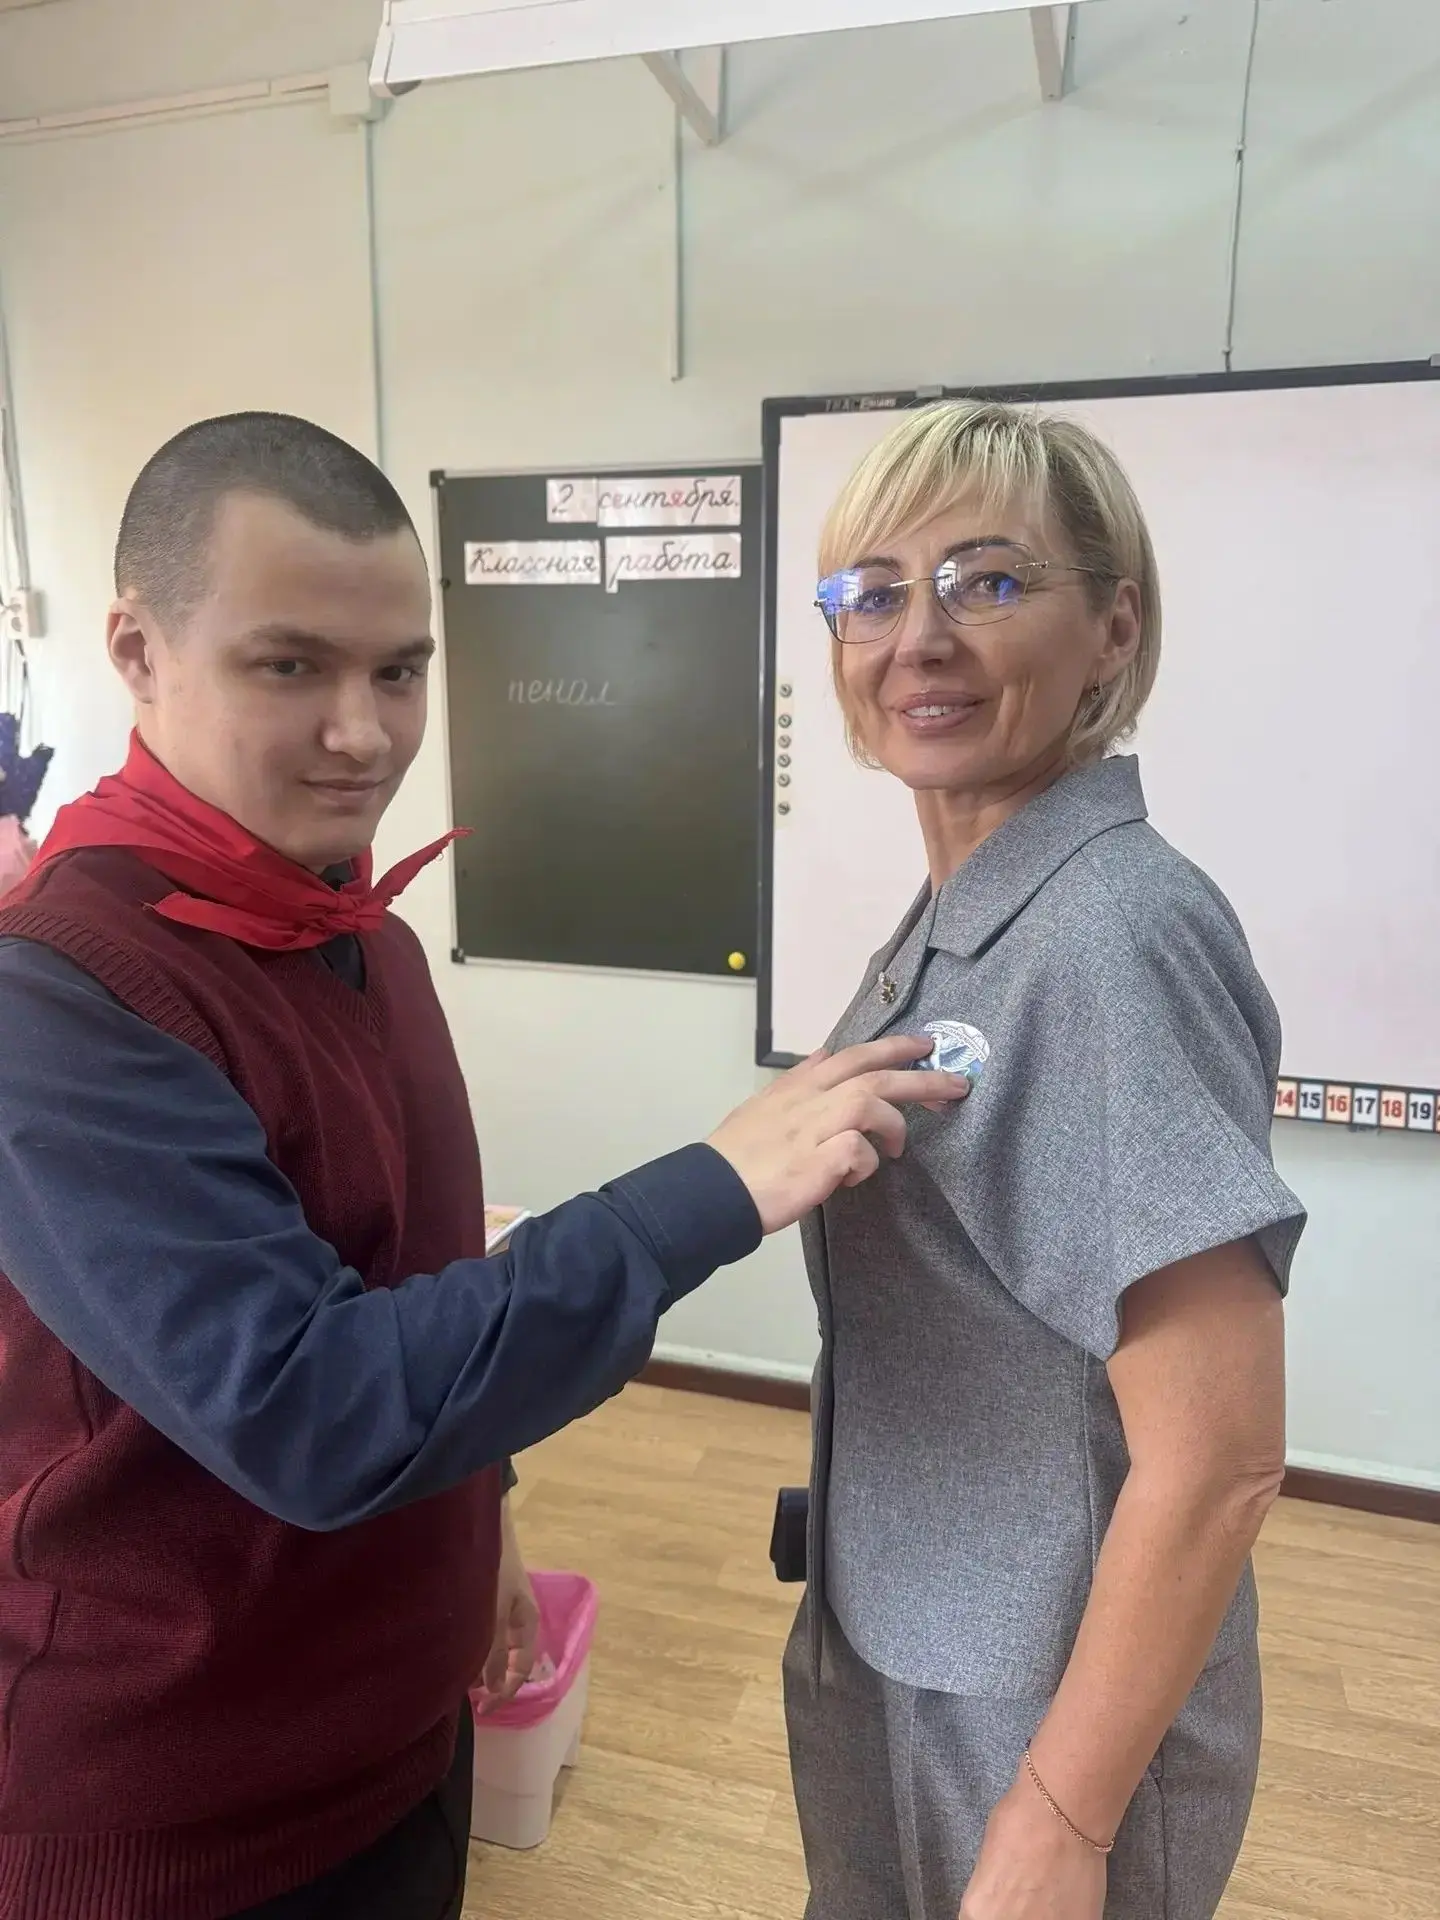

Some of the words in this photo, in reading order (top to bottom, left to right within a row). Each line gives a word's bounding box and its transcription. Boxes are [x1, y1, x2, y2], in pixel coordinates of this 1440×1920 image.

[551, 483, 574, 514] 2
[469, 548, 598, 575] Классная
[508, 678, 616, 706] пенал
[1276, 1089, 1294, 1107] 14
[1300, 1091, 1321, 1110] 15
[1327, 1094, 1348, 1113] 16
[1354, 1096, 1377, 1115] 17
[1382, 1099, 1402, 1118] 18
[1410, 1101, 1432, 1120] 19
